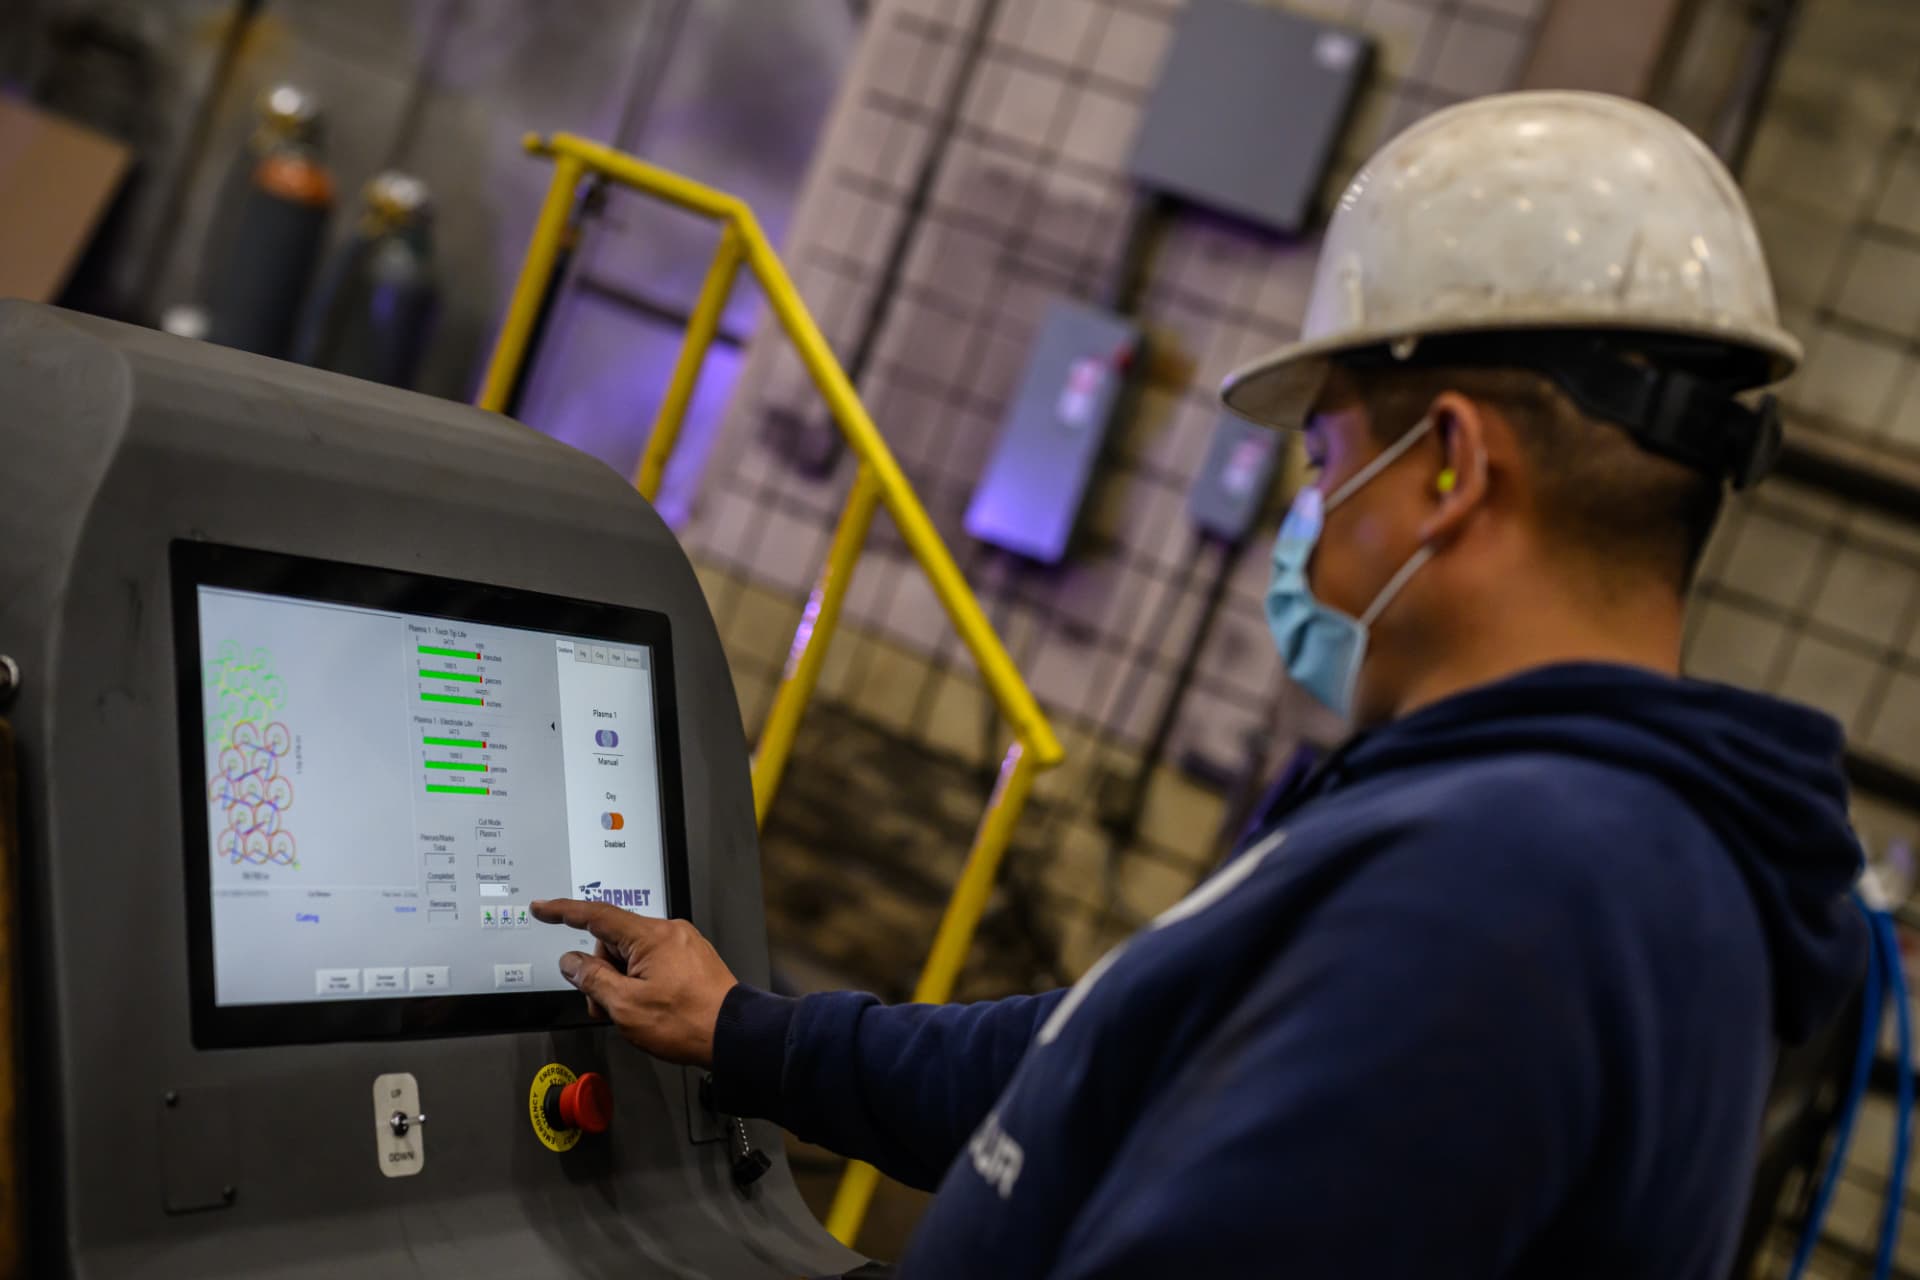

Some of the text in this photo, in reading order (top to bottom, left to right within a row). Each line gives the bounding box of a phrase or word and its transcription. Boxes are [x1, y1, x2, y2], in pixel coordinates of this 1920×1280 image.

[592, 709, 612, 718] Plasma
[598, 758, 618, 766] Manual
[604, 840, 626, 849] Disabled
[391, 1088, 402, 1098] UP
[389, 1151, 415, 1162] DOWN
